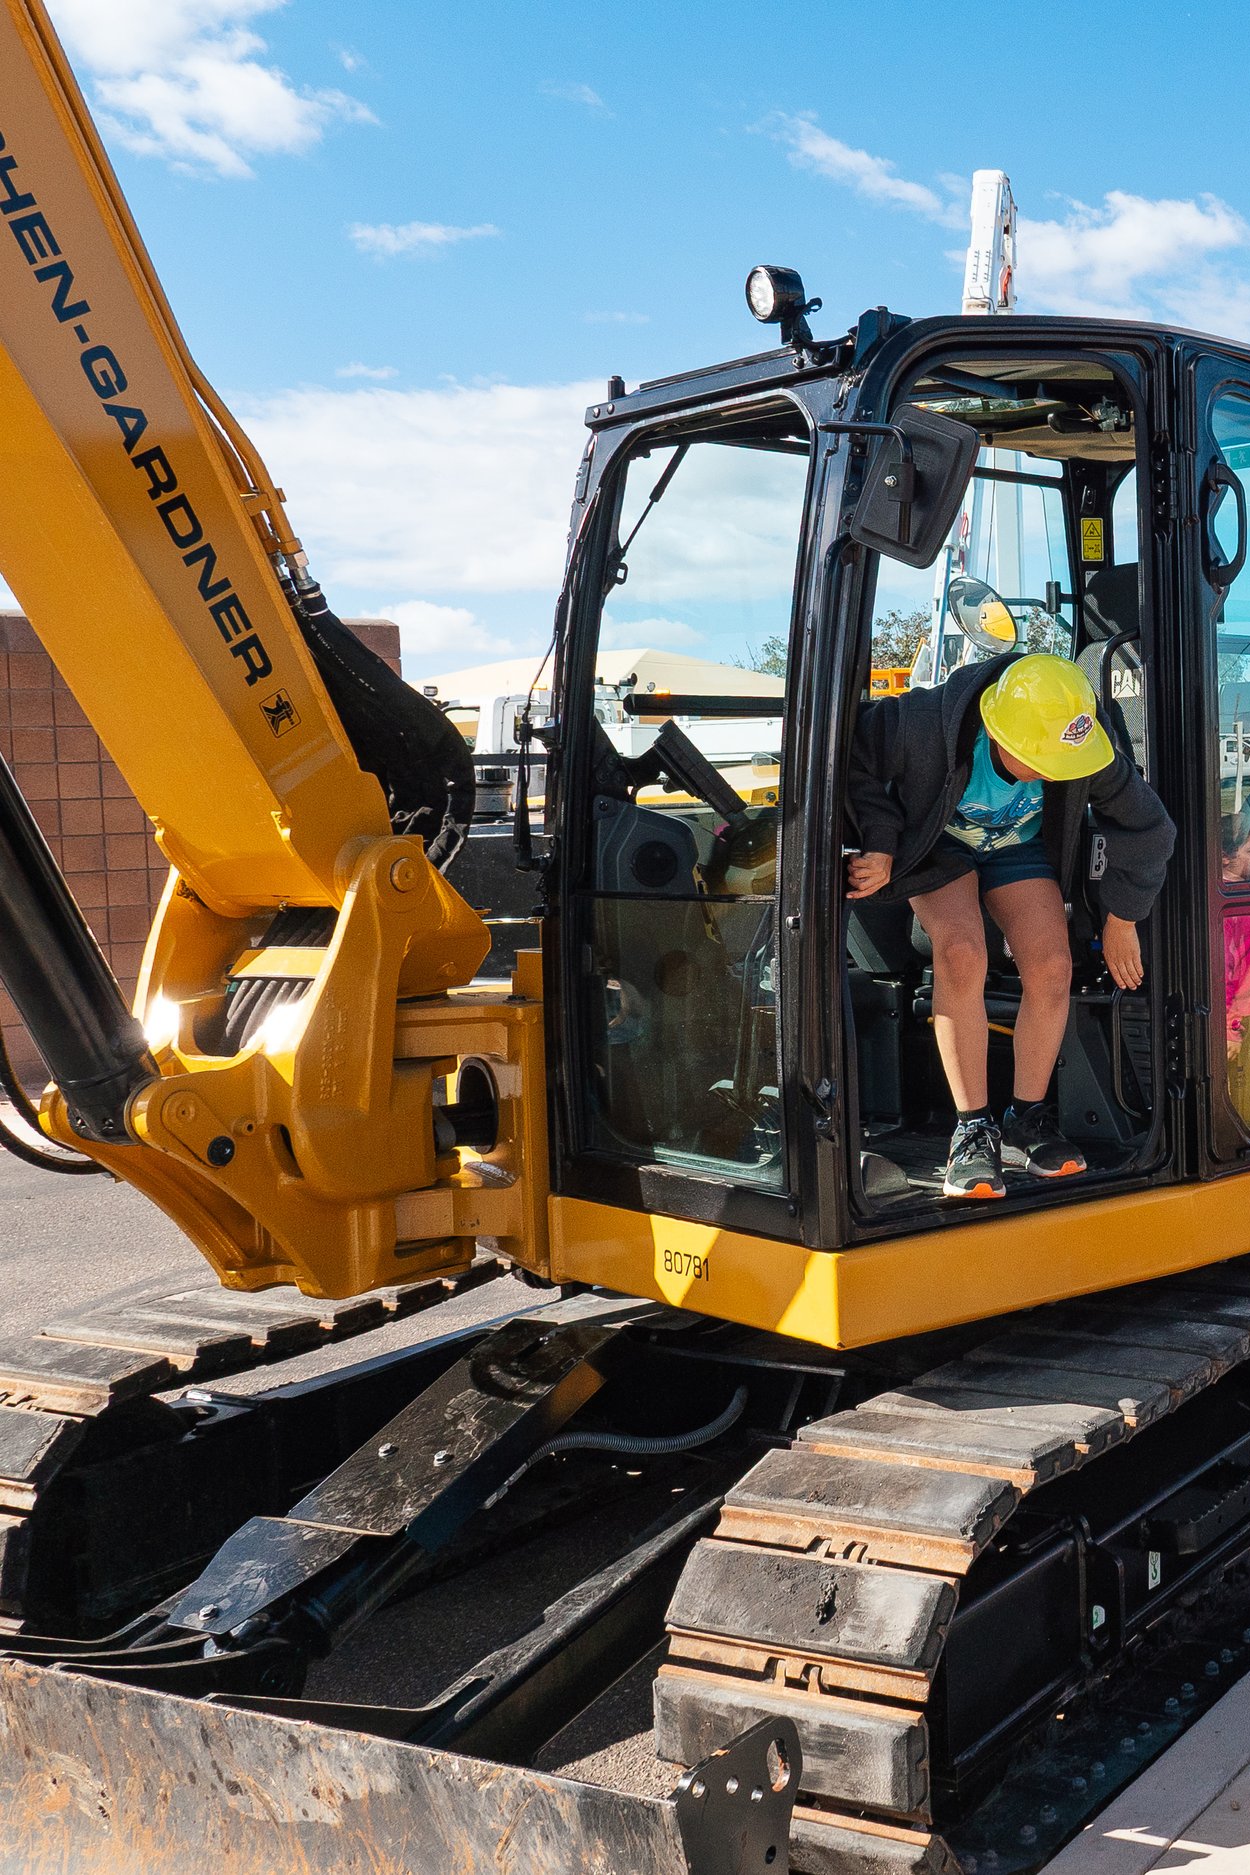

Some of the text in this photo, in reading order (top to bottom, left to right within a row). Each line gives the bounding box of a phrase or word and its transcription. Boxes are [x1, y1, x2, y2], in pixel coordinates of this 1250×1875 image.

[0, 131, 273, 687] HEN-GARDNER
[1111, 669, 1141, 699] CAT
[664, 1249, 709, 1281] 80781
